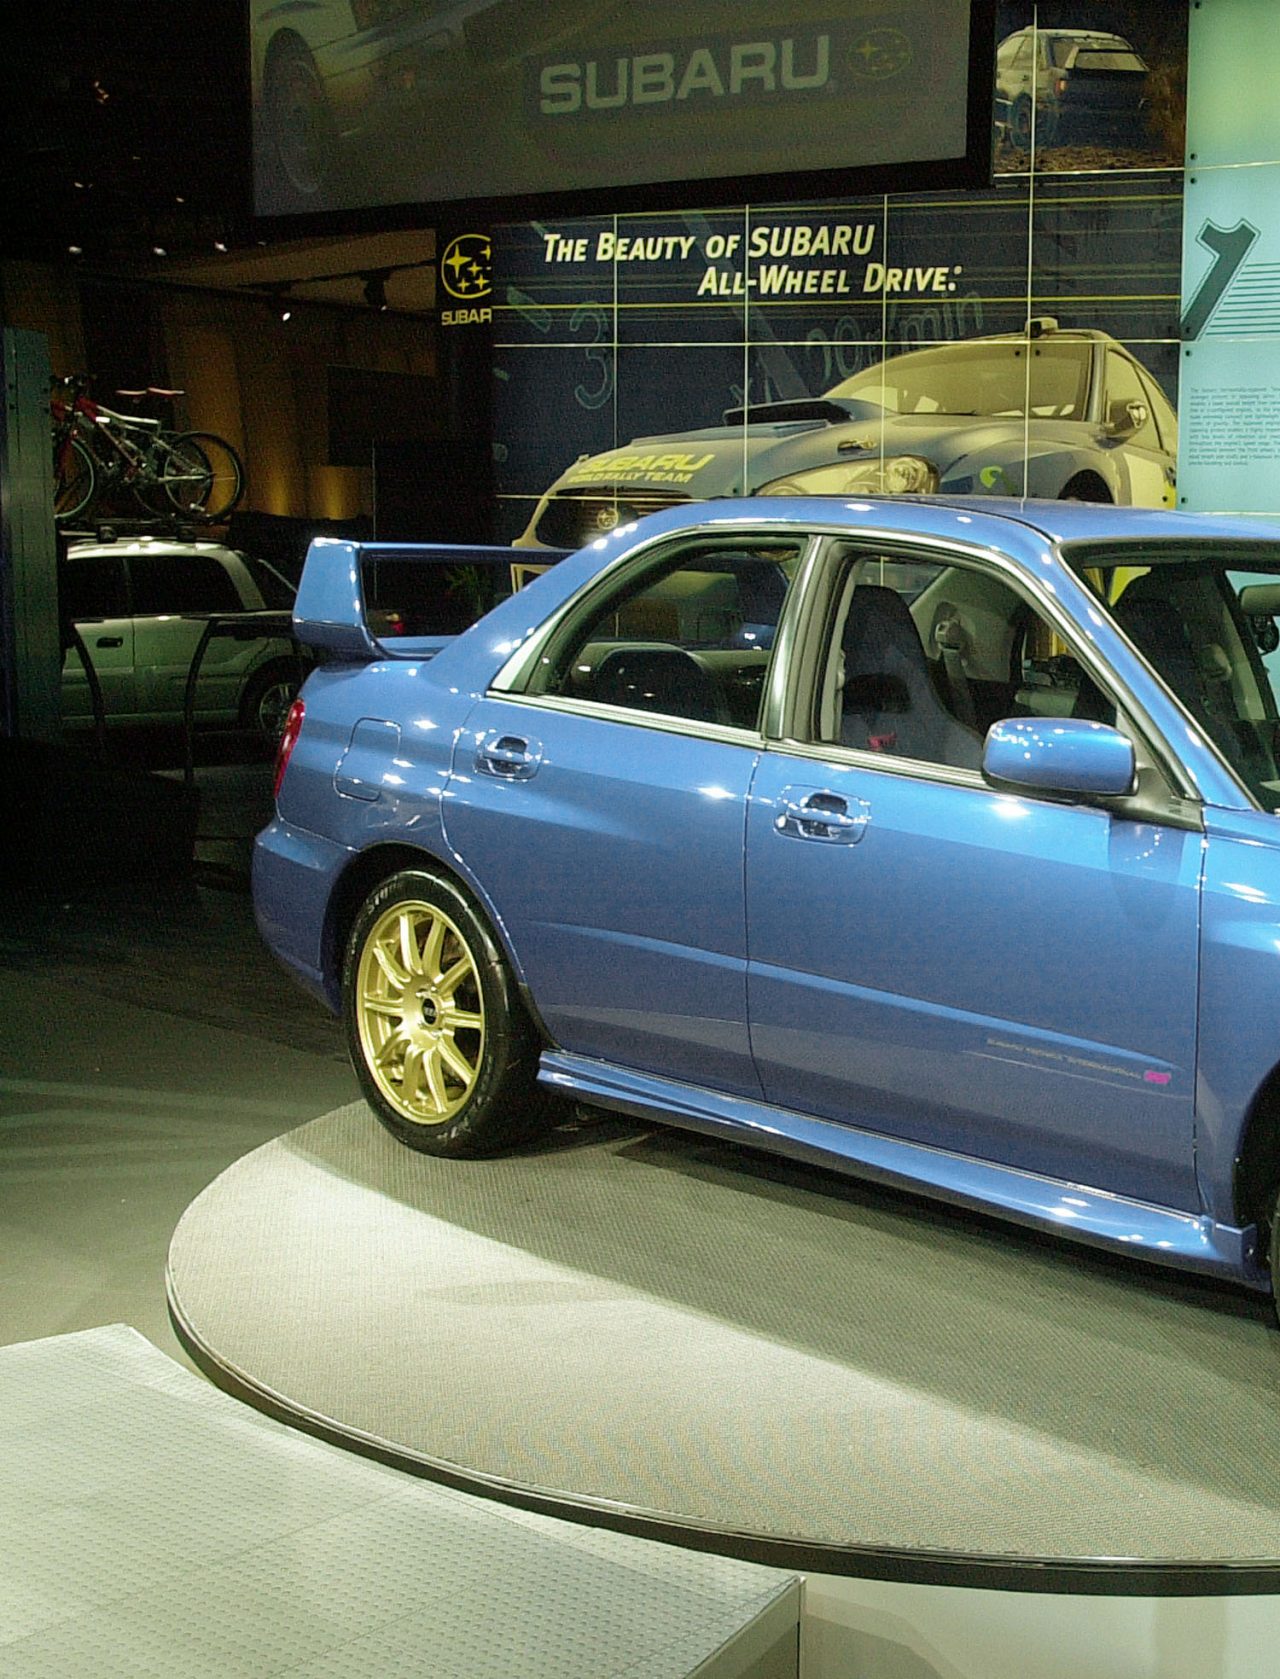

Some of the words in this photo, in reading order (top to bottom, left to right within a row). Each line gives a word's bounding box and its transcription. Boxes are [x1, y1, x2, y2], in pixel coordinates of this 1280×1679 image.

[540, 34, 830, 115] SUBARU
[543, 233, 589, 263] THE
[595, 231, 697, 262] BEAUTY
[748, 224, 875, 258] SUBARU
